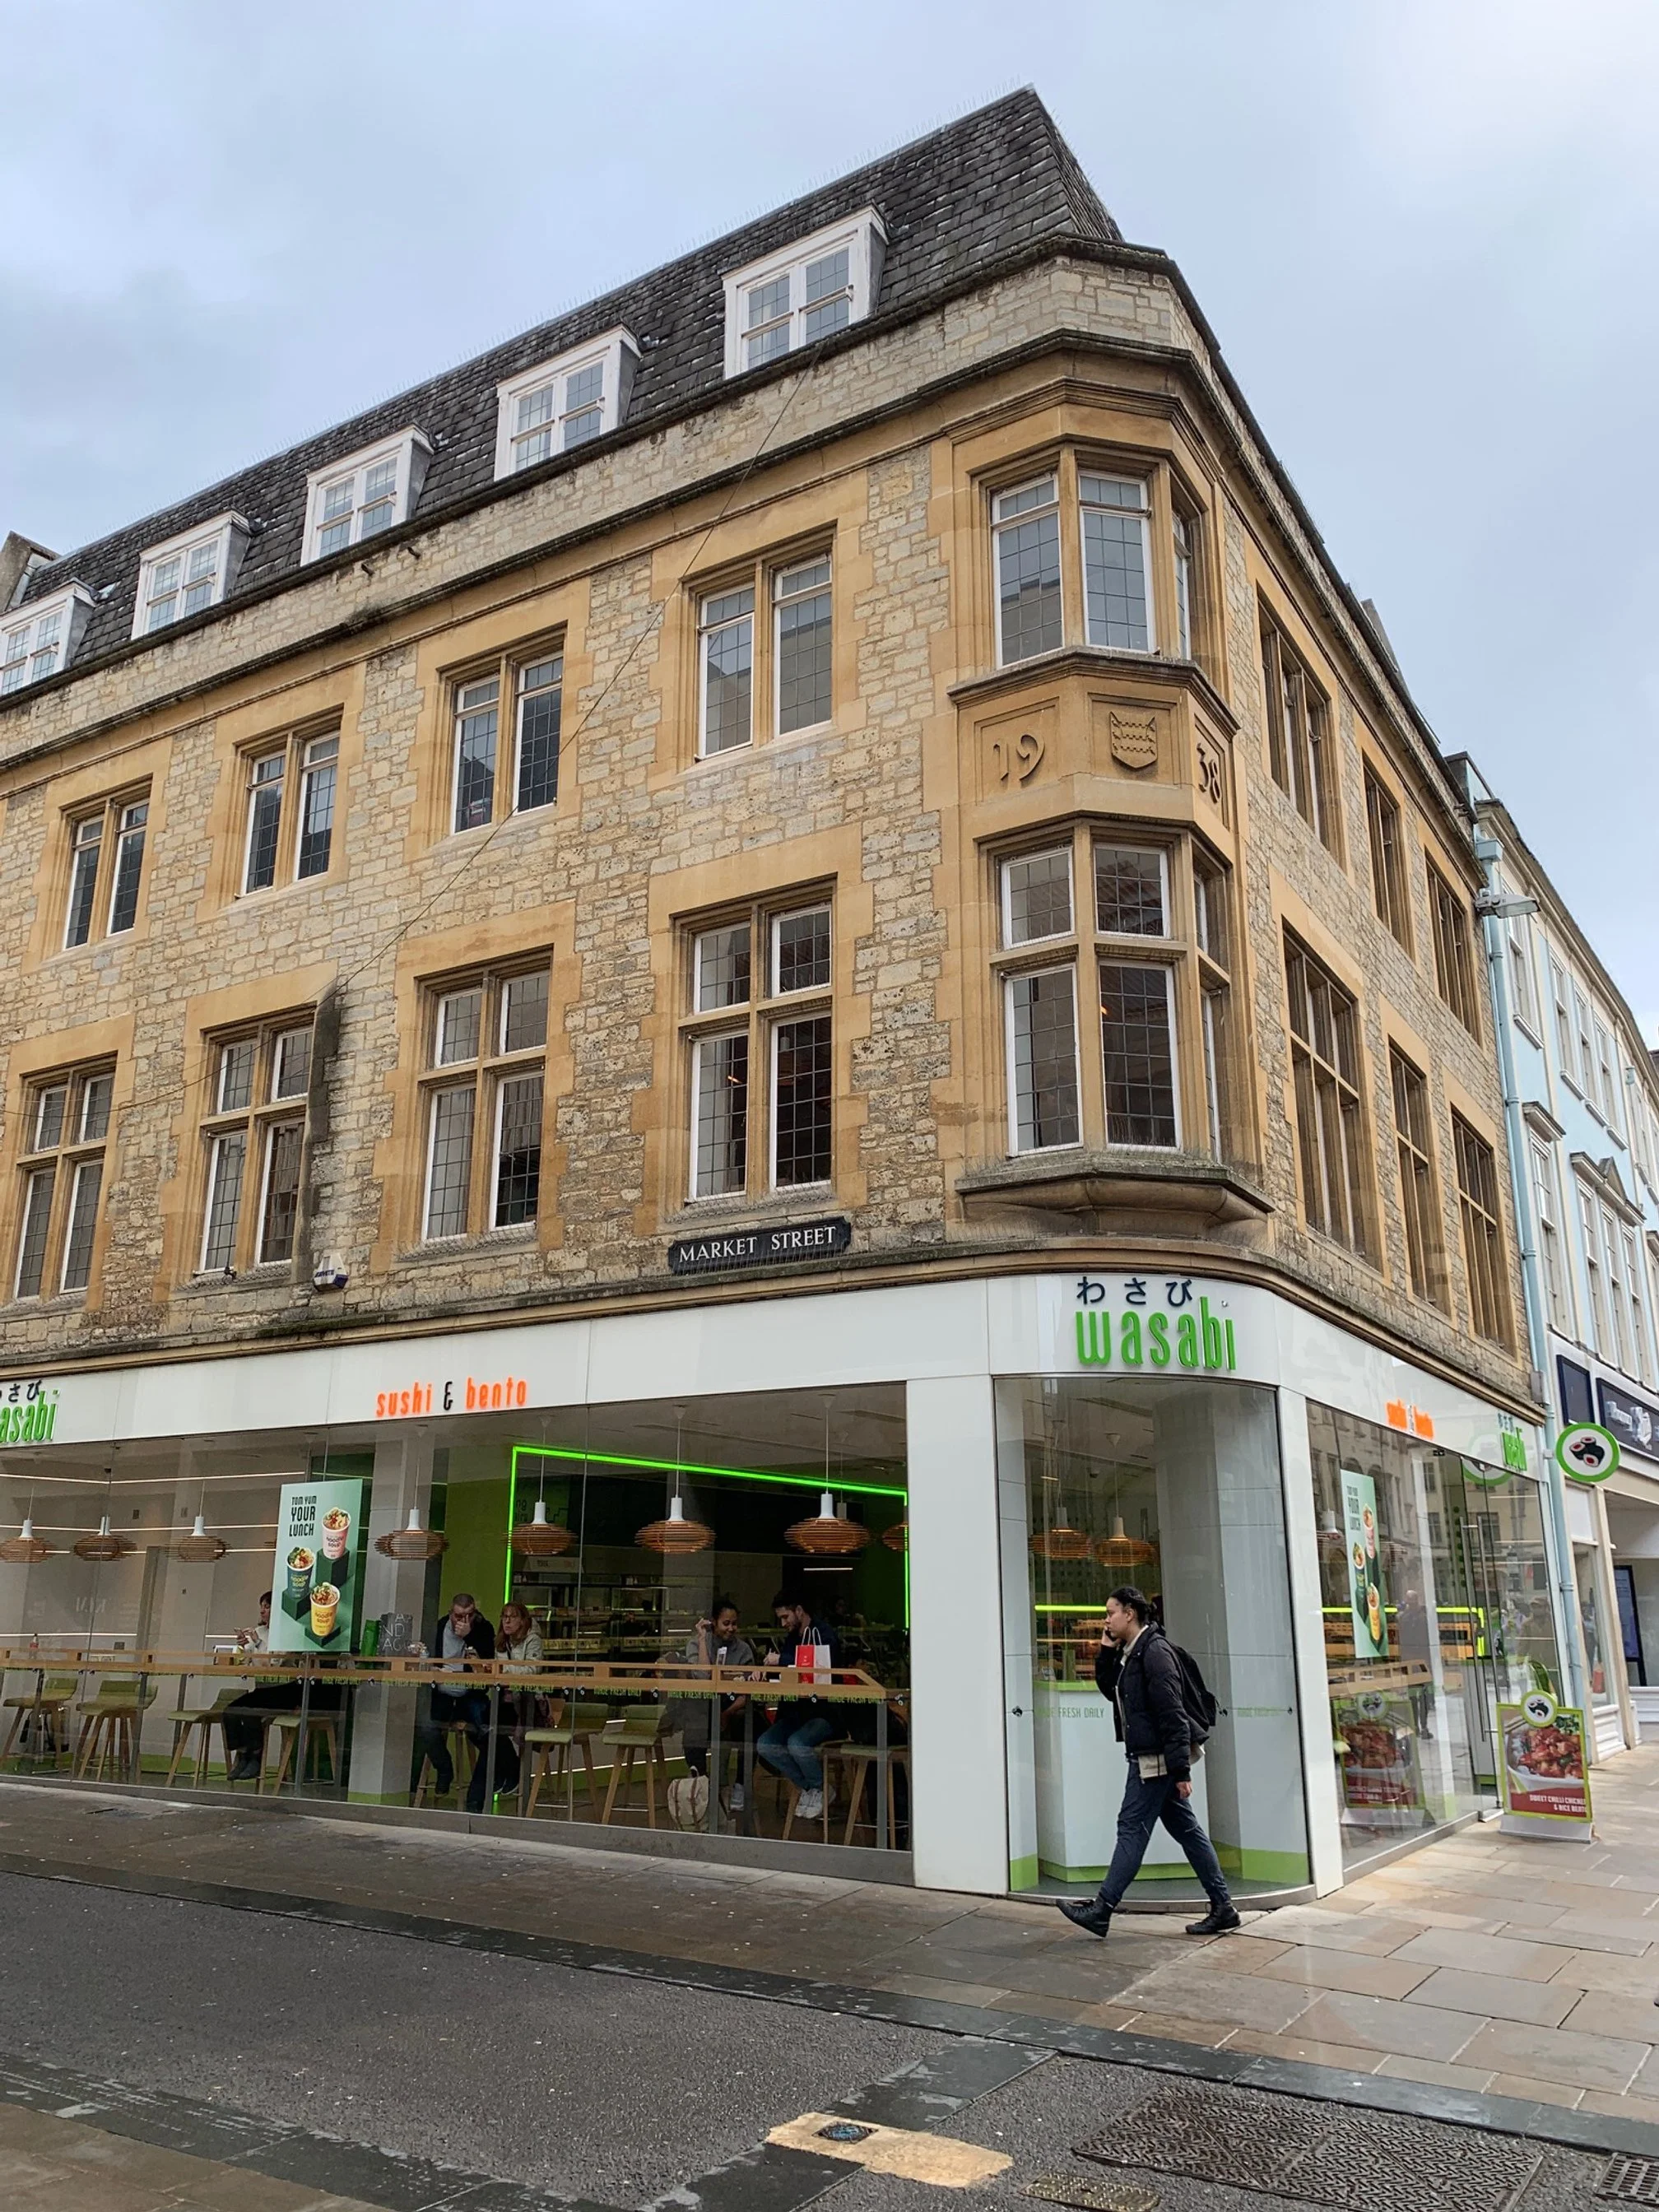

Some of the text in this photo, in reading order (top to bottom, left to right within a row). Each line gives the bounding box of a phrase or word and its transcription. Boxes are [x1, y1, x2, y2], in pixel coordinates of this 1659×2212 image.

[993, 734, 1047, 782] 19
[1197, 742, 1222, 805] 38
[679, 1226, 837, 1263] MARKET STREET
[1076, 1276, 1194, 1308] わさび
[1075, 1296, 1237, 1371] wasabi
[0, 1379, 43, 1403] さび
[376, 1376, 527, 1418] sushi & bento
[0, 1390, 60, 1443] asabi
[289, 1523, 314, 1536] LUNCH
[290, 1505, 316, 1522] YOUR
[1058, 1707, 1081, 1718] FRESH
[1084, 1707, 1105, 1718] DAILY
